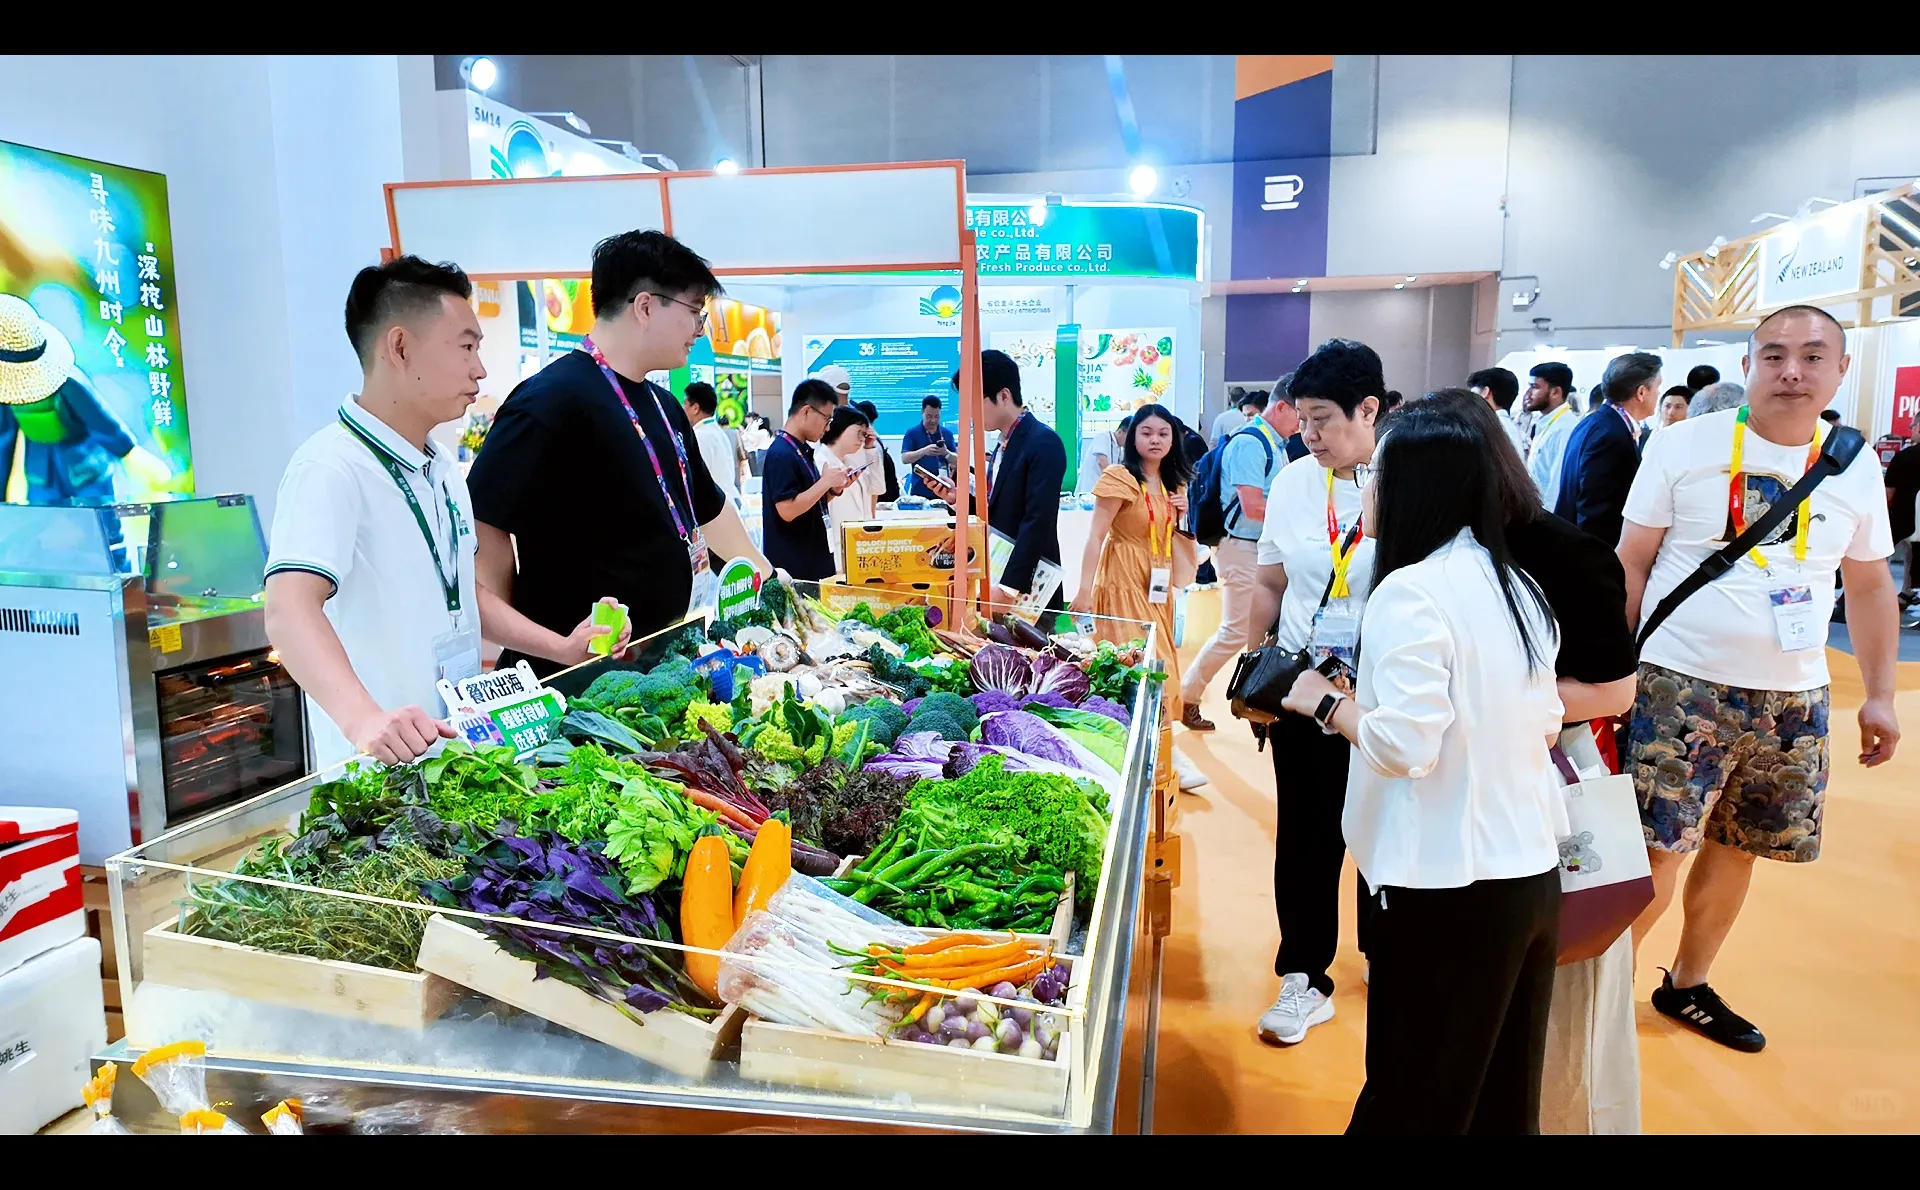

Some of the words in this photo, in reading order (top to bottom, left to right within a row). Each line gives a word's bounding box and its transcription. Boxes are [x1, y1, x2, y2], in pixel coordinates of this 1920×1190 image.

[475, 107, 501, 128] 5M14
[976, 243, 1112, 261] 农产品有限公司
[980, 262, 1011, 272] Fresh
[1015, 262, 1063, 272] Produce
[1791, 266, 1808, 280] NEW
[1808, 256, 1844, 276] ZEALAND
[887, 545, 924, 553] POTATO
[466, 673, 525, 704] 餐饮出海
